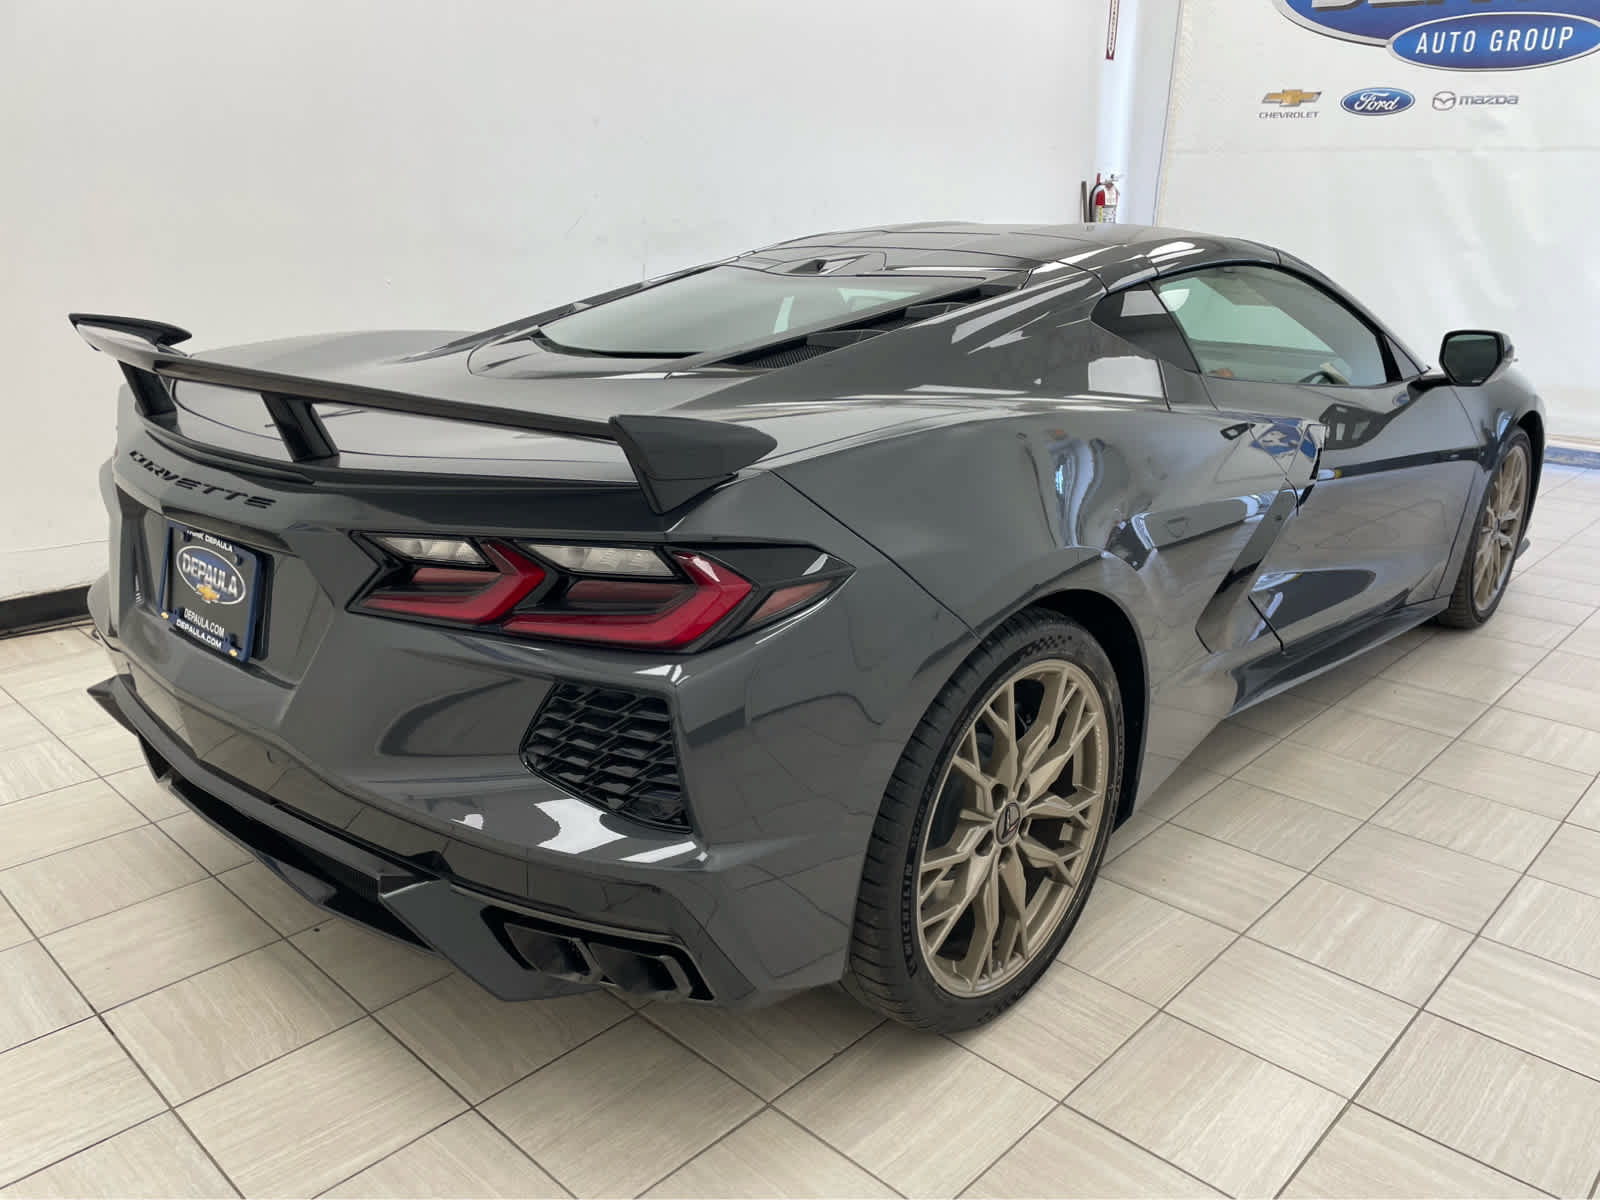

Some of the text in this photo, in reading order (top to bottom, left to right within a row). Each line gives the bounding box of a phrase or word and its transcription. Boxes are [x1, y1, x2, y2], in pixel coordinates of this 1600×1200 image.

[1416, 26, 1574, 54] AUTO GROUP
[1258, 111, 1320, 120] CHEVROLET
[1353, 92, 1398, 113] Ford
[129, 450, 277, 509] CORVETTE
[205, 534, 233, 552] DEPAULA
[182, 553, 238, 597] DEPAULA
[176, 618, 222, 650] DEPAULA.COM
[184, 607, 225, 637] DEPAULA.COM
[902, 864, 914, 956] MICHELIN
